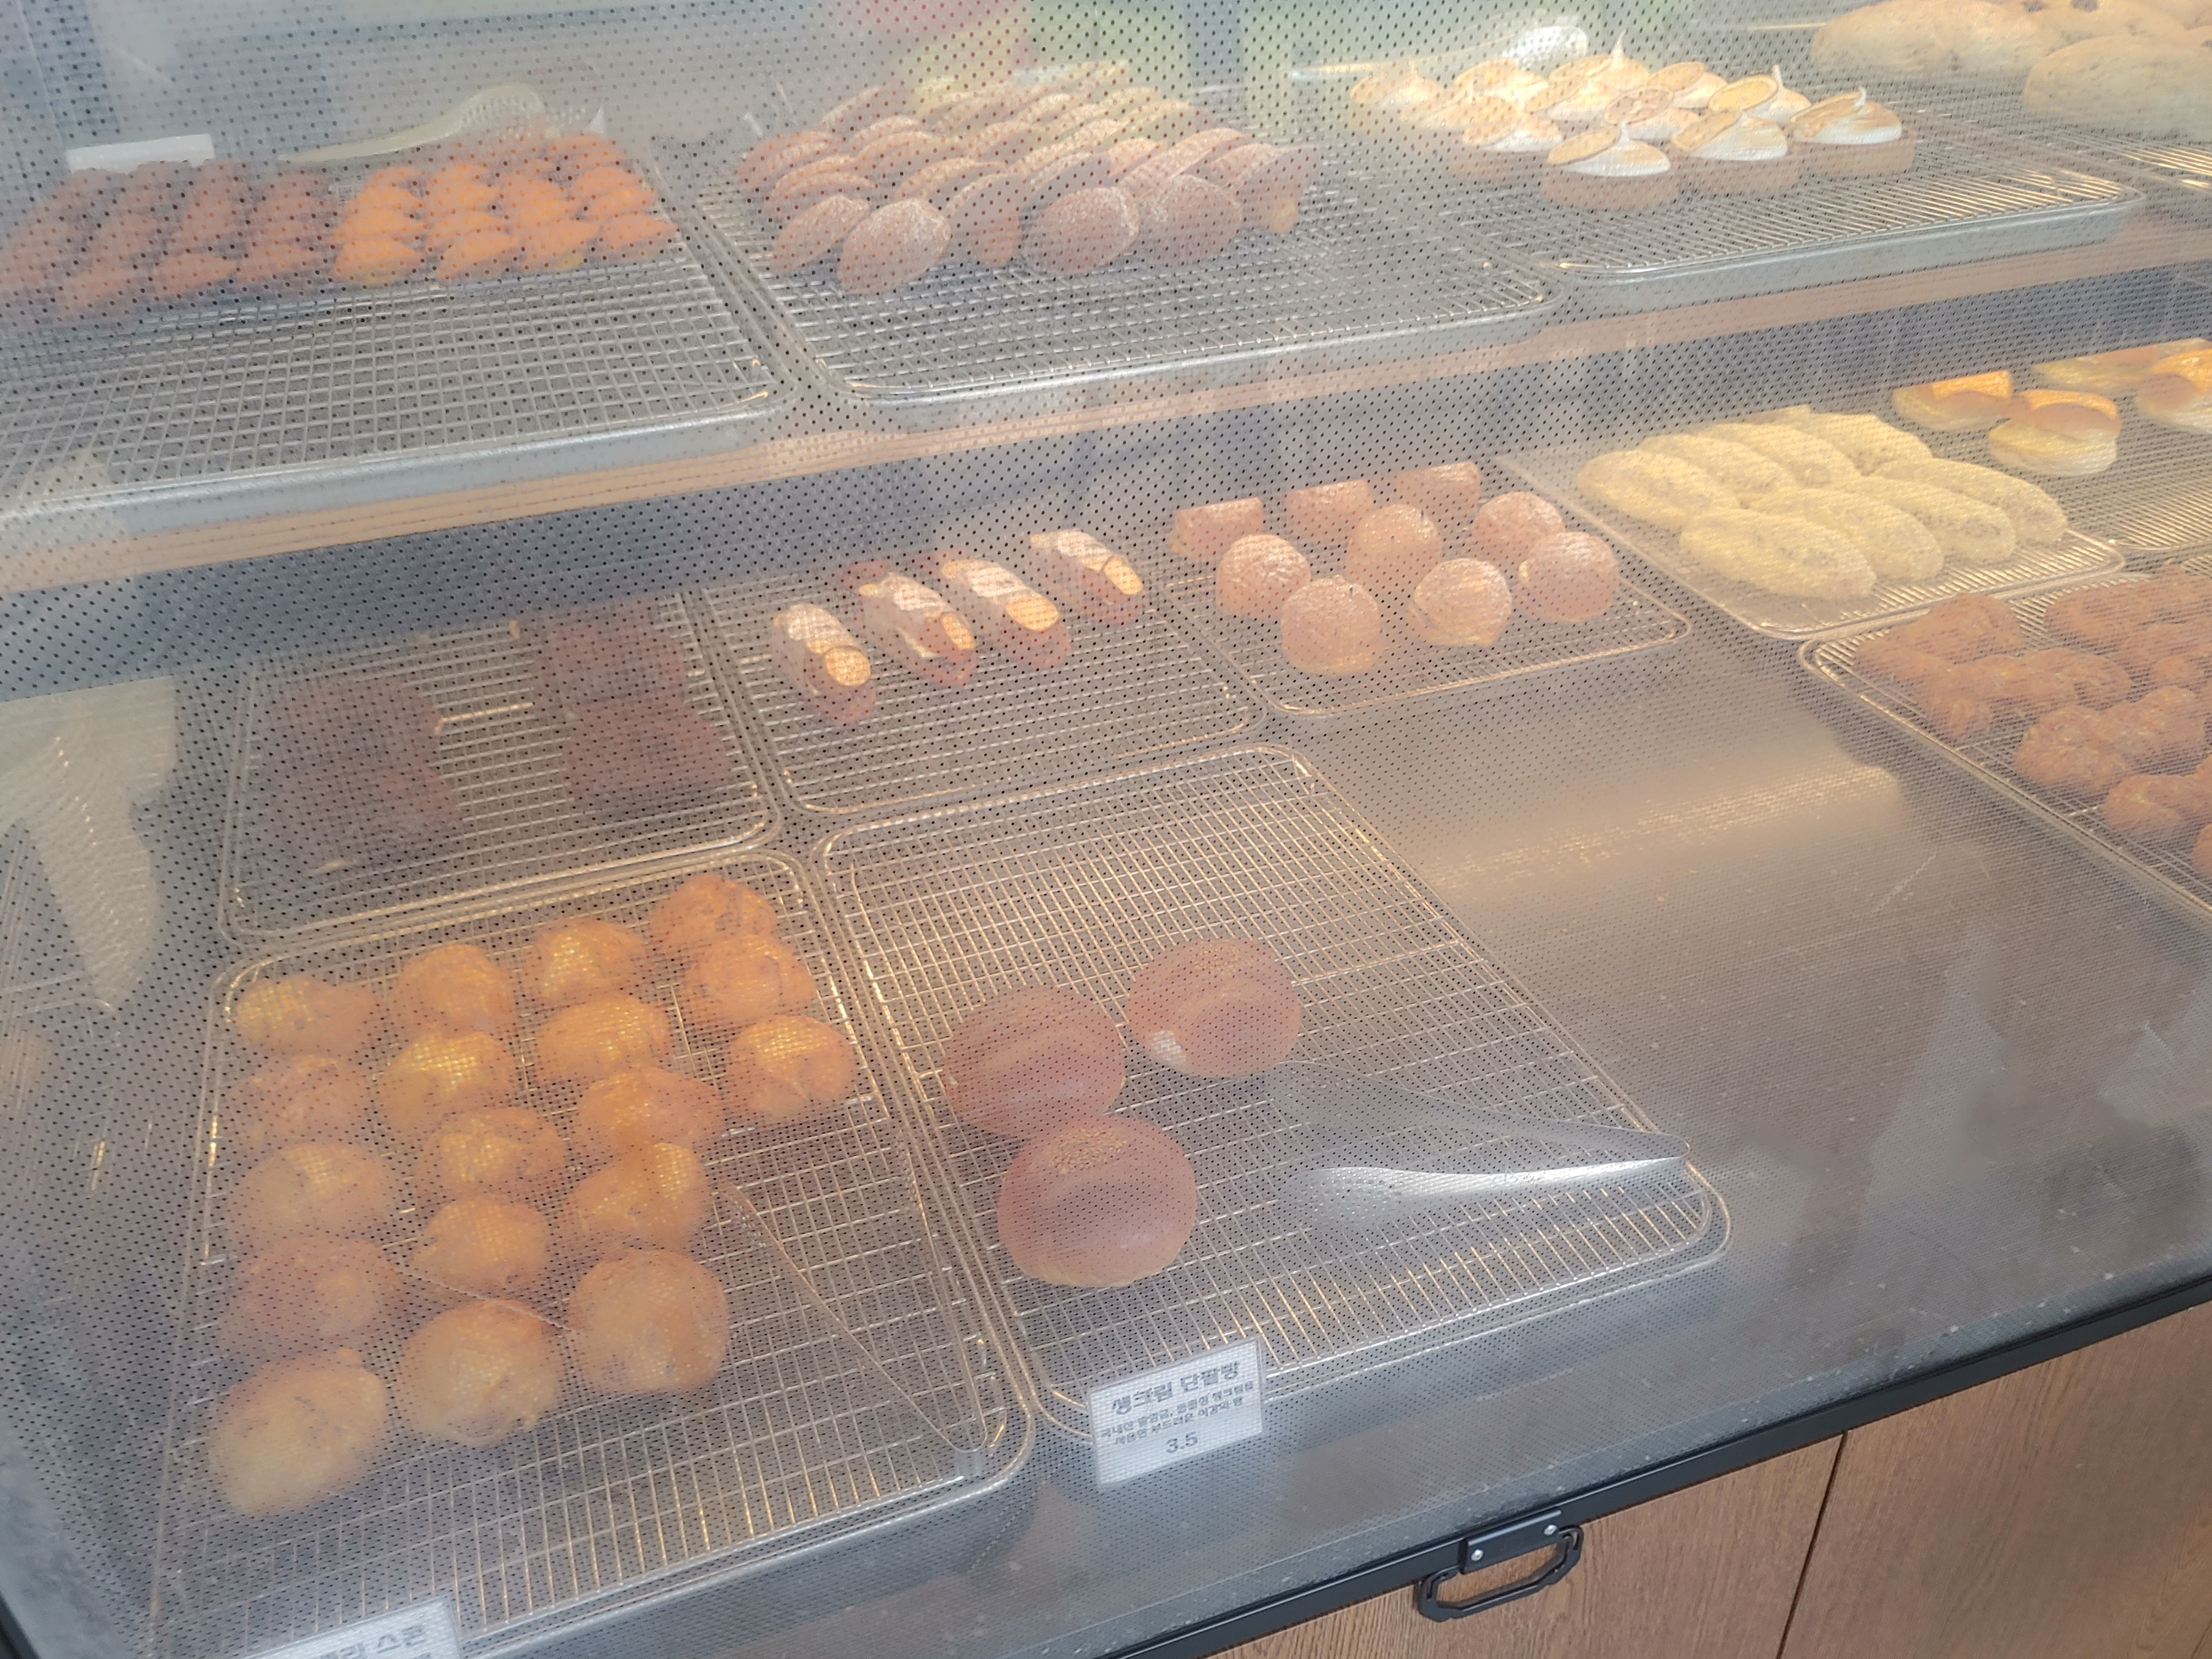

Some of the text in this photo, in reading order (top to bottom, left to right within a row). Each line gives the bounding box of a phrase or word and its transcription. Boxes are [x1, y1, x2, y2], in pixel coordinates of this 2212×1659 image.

[1113, 1361, 1240, 1414] 생크림 단팥빵
[1101, 1421, 1134, 1438] 국내산
[1177, 1395, 1209, 1414] 동물성
[1115, 1429, 1148, 1444] 사용한
[1152, 1413, 1194, 1433] 부드러운
[1233, 1395, 1243, 1406] 빵
[1166, 1431, 1198, 1453] 3.5
[377, 1624, 427, 1654] 스콘
